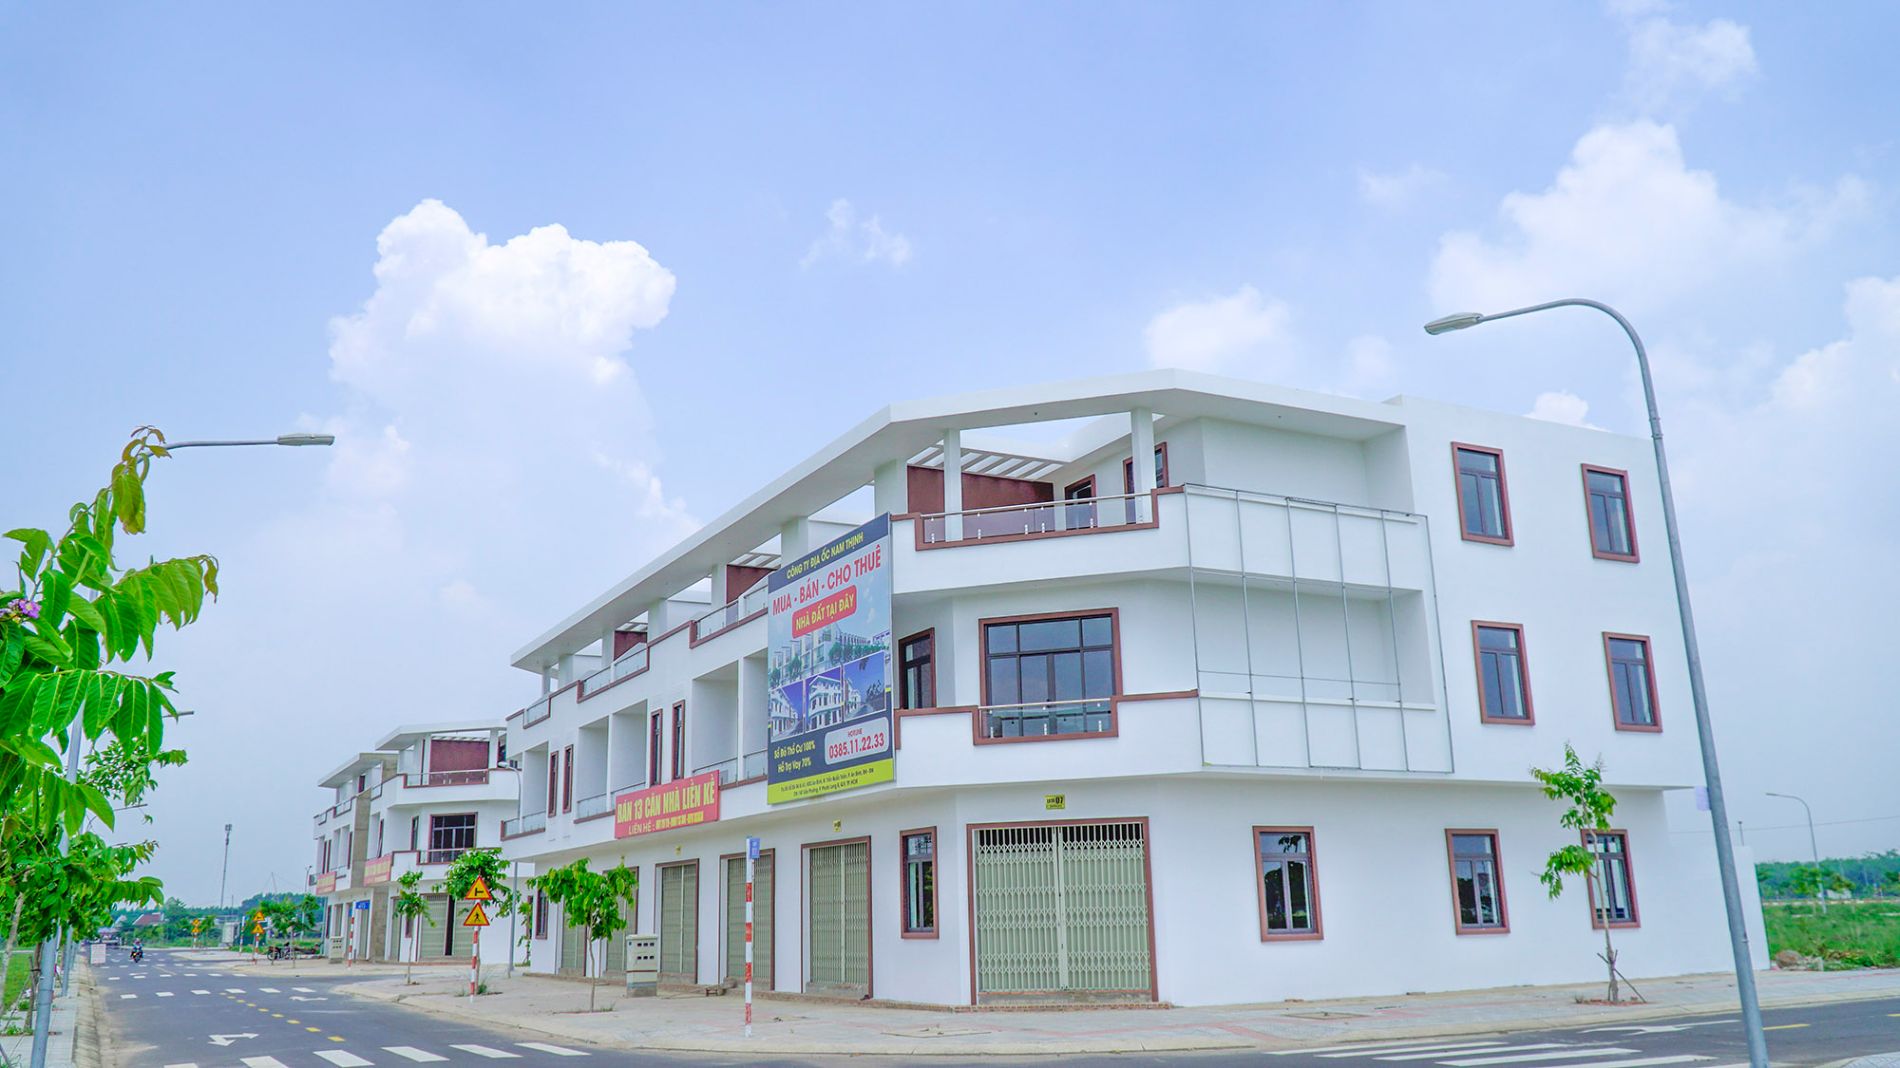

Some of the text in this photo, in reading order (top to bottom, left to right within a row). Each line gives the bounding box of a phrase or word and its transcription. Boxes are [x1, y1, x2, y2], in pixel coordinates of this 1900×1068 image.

[787, 563, 803, 579] CÔNG
[810, 554, 820, 569] ĐỊA
[821, 547, 830, 561] ỐC
[831, 541, 845, 556] NAM
[845, 531, 864, 550] THỊNH
[773, 544, 881, 615] MUA BÁN CHO THUÊ
[796, 592, 854, 631] NHÀ ĐẤT TẠI ĐÂY
[829, 731, 884, 759] 0385.11.22.33
[617, 799, 633, 823] BÁN
[634, 798, 643, 820] 13
[663, 786, 681, 814] NHÀ
